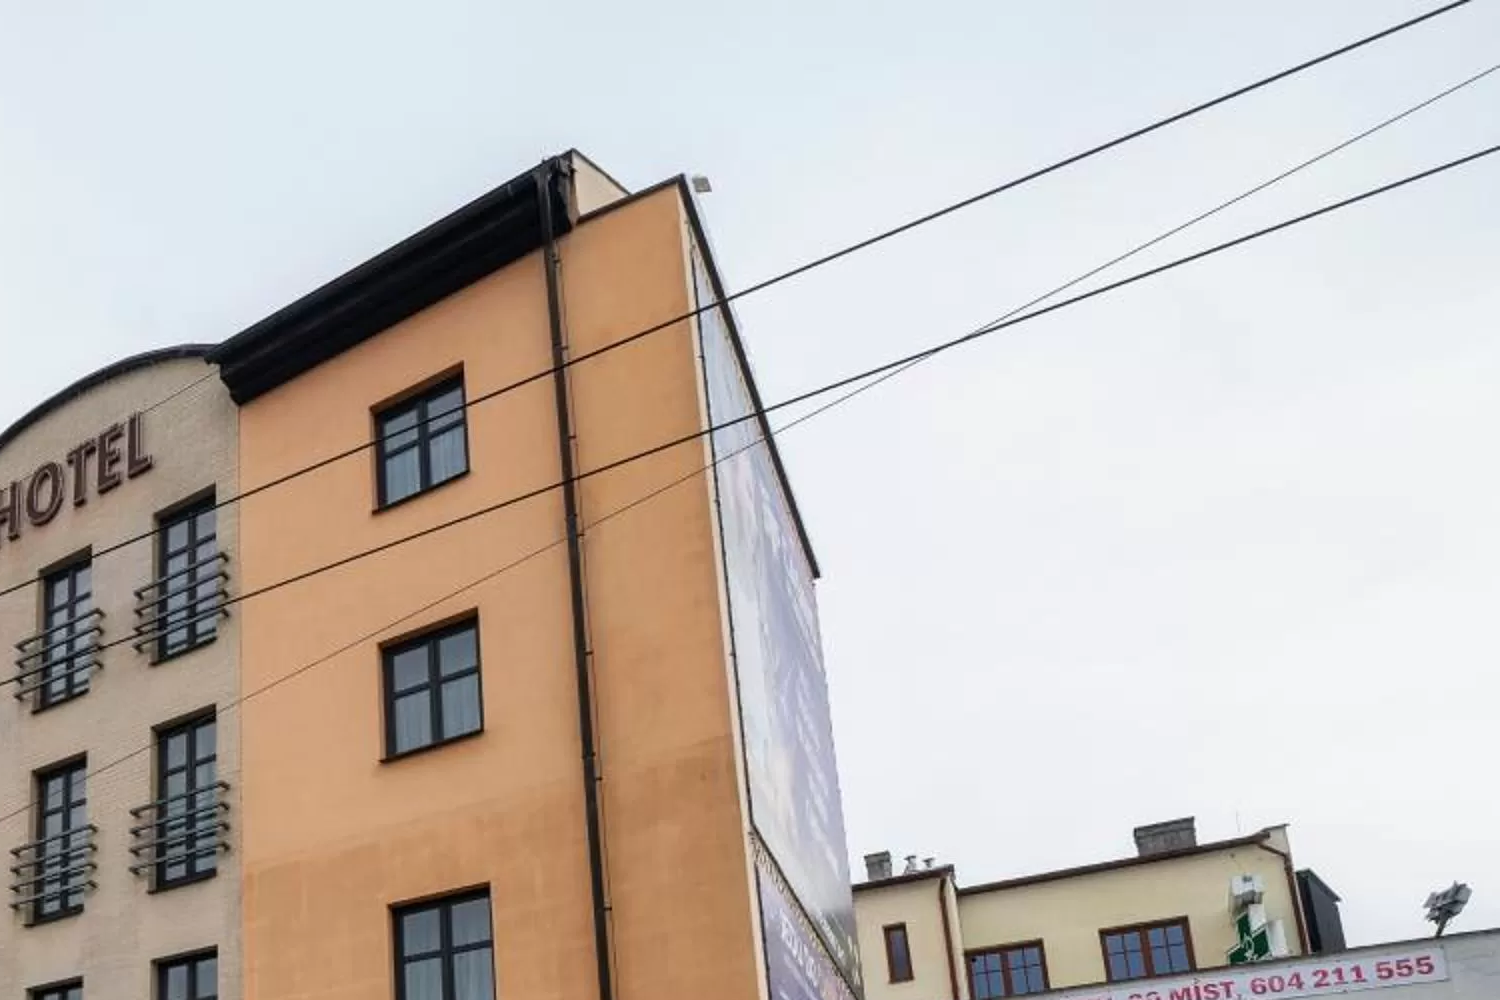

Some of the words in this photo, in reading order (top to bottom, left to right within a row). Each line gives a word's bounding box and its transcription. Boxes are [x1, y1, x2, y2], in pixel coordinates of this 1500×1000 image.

[1250, 971, 1305, 996] 604
[1313, 964, 1367, 988] 211
[1375, 955, 1436, 981] 555
